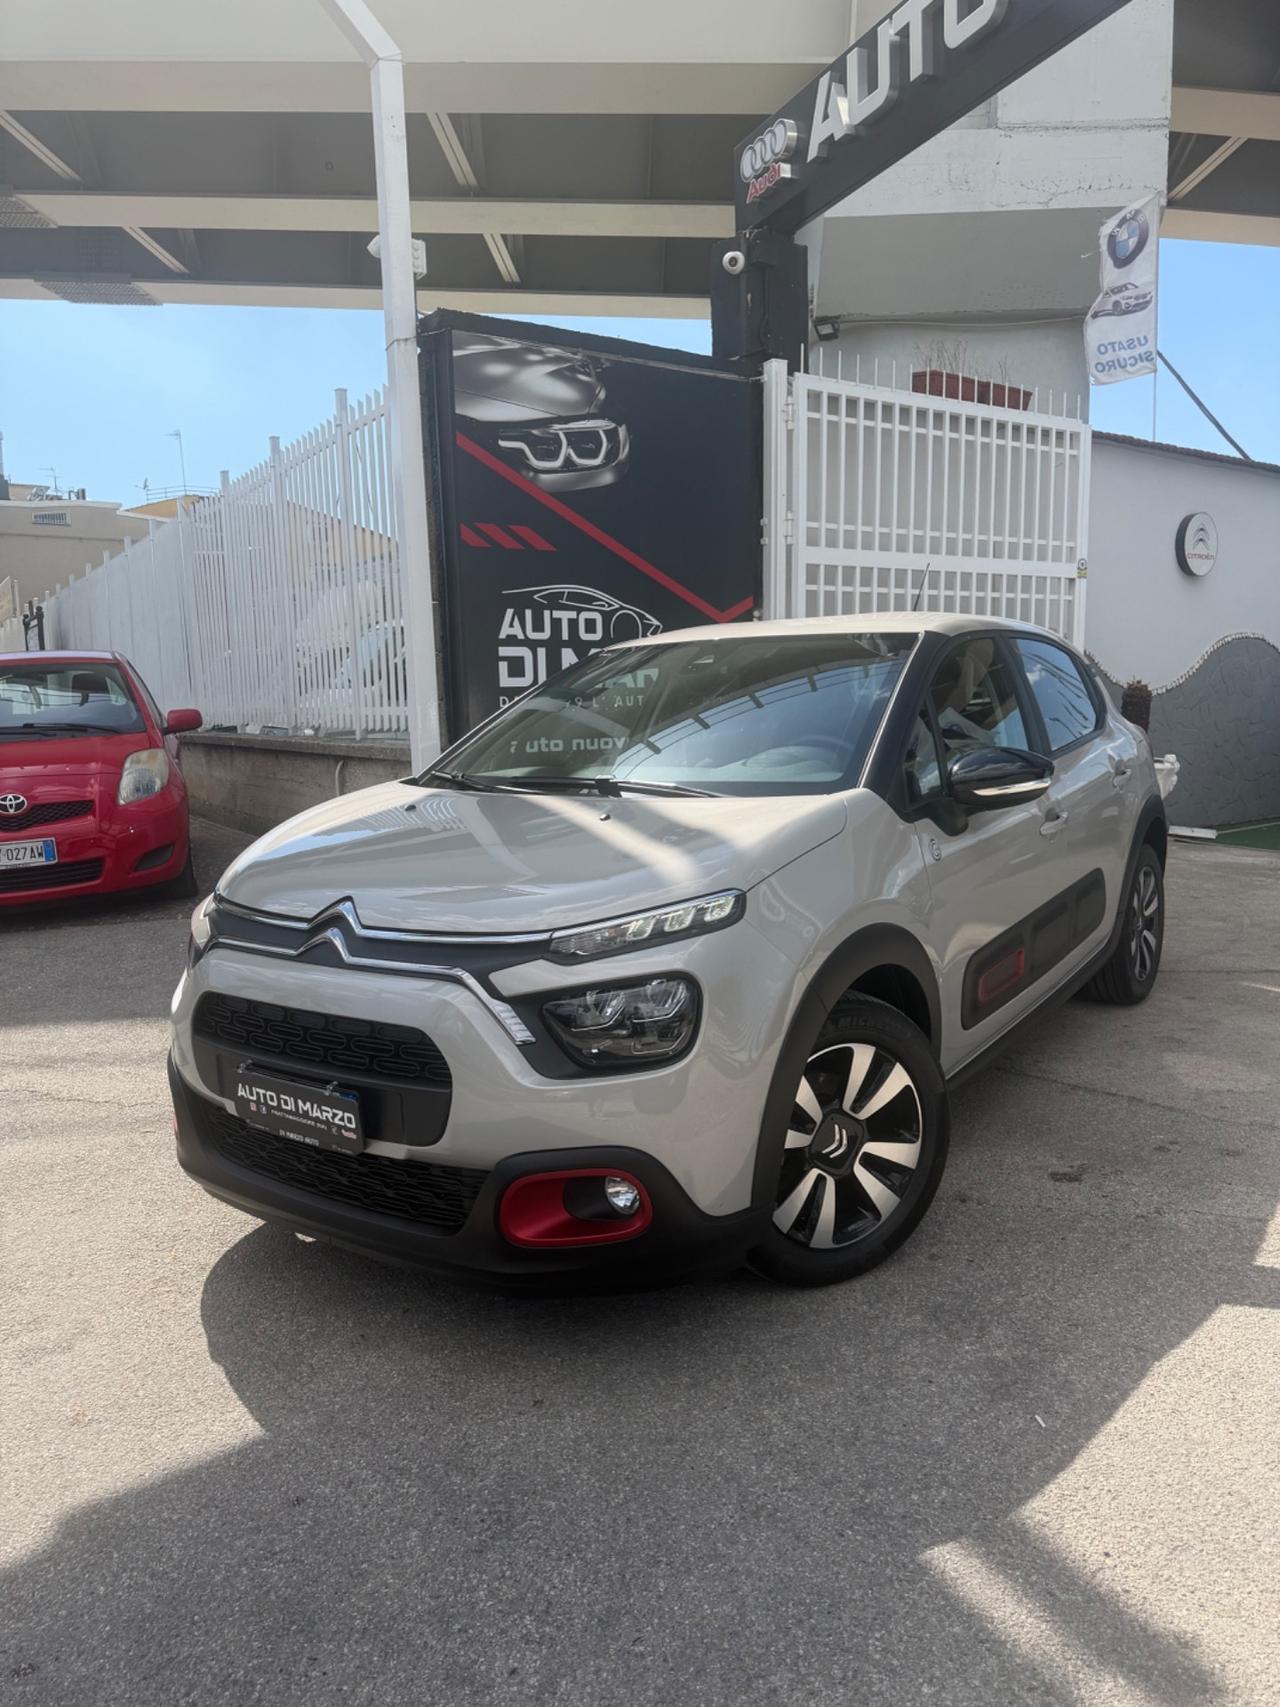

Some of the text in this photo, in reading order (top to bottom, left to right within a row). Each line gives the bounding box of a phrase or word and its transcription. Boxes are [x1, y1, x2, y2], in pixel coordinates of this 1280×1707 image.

[746, 162, 783, 204] Audi
[498, 608, 604, 641] AUTO
[498, 646, 547, 688] DI
[614, 695, 645, 708] AUT
[572, 736, 630, 751] nuov
[238, 1083, 278, 1107] AUTO
[280, 1094, 296, 1112] DI
[297, 1099, 356, 1129] MARZO
